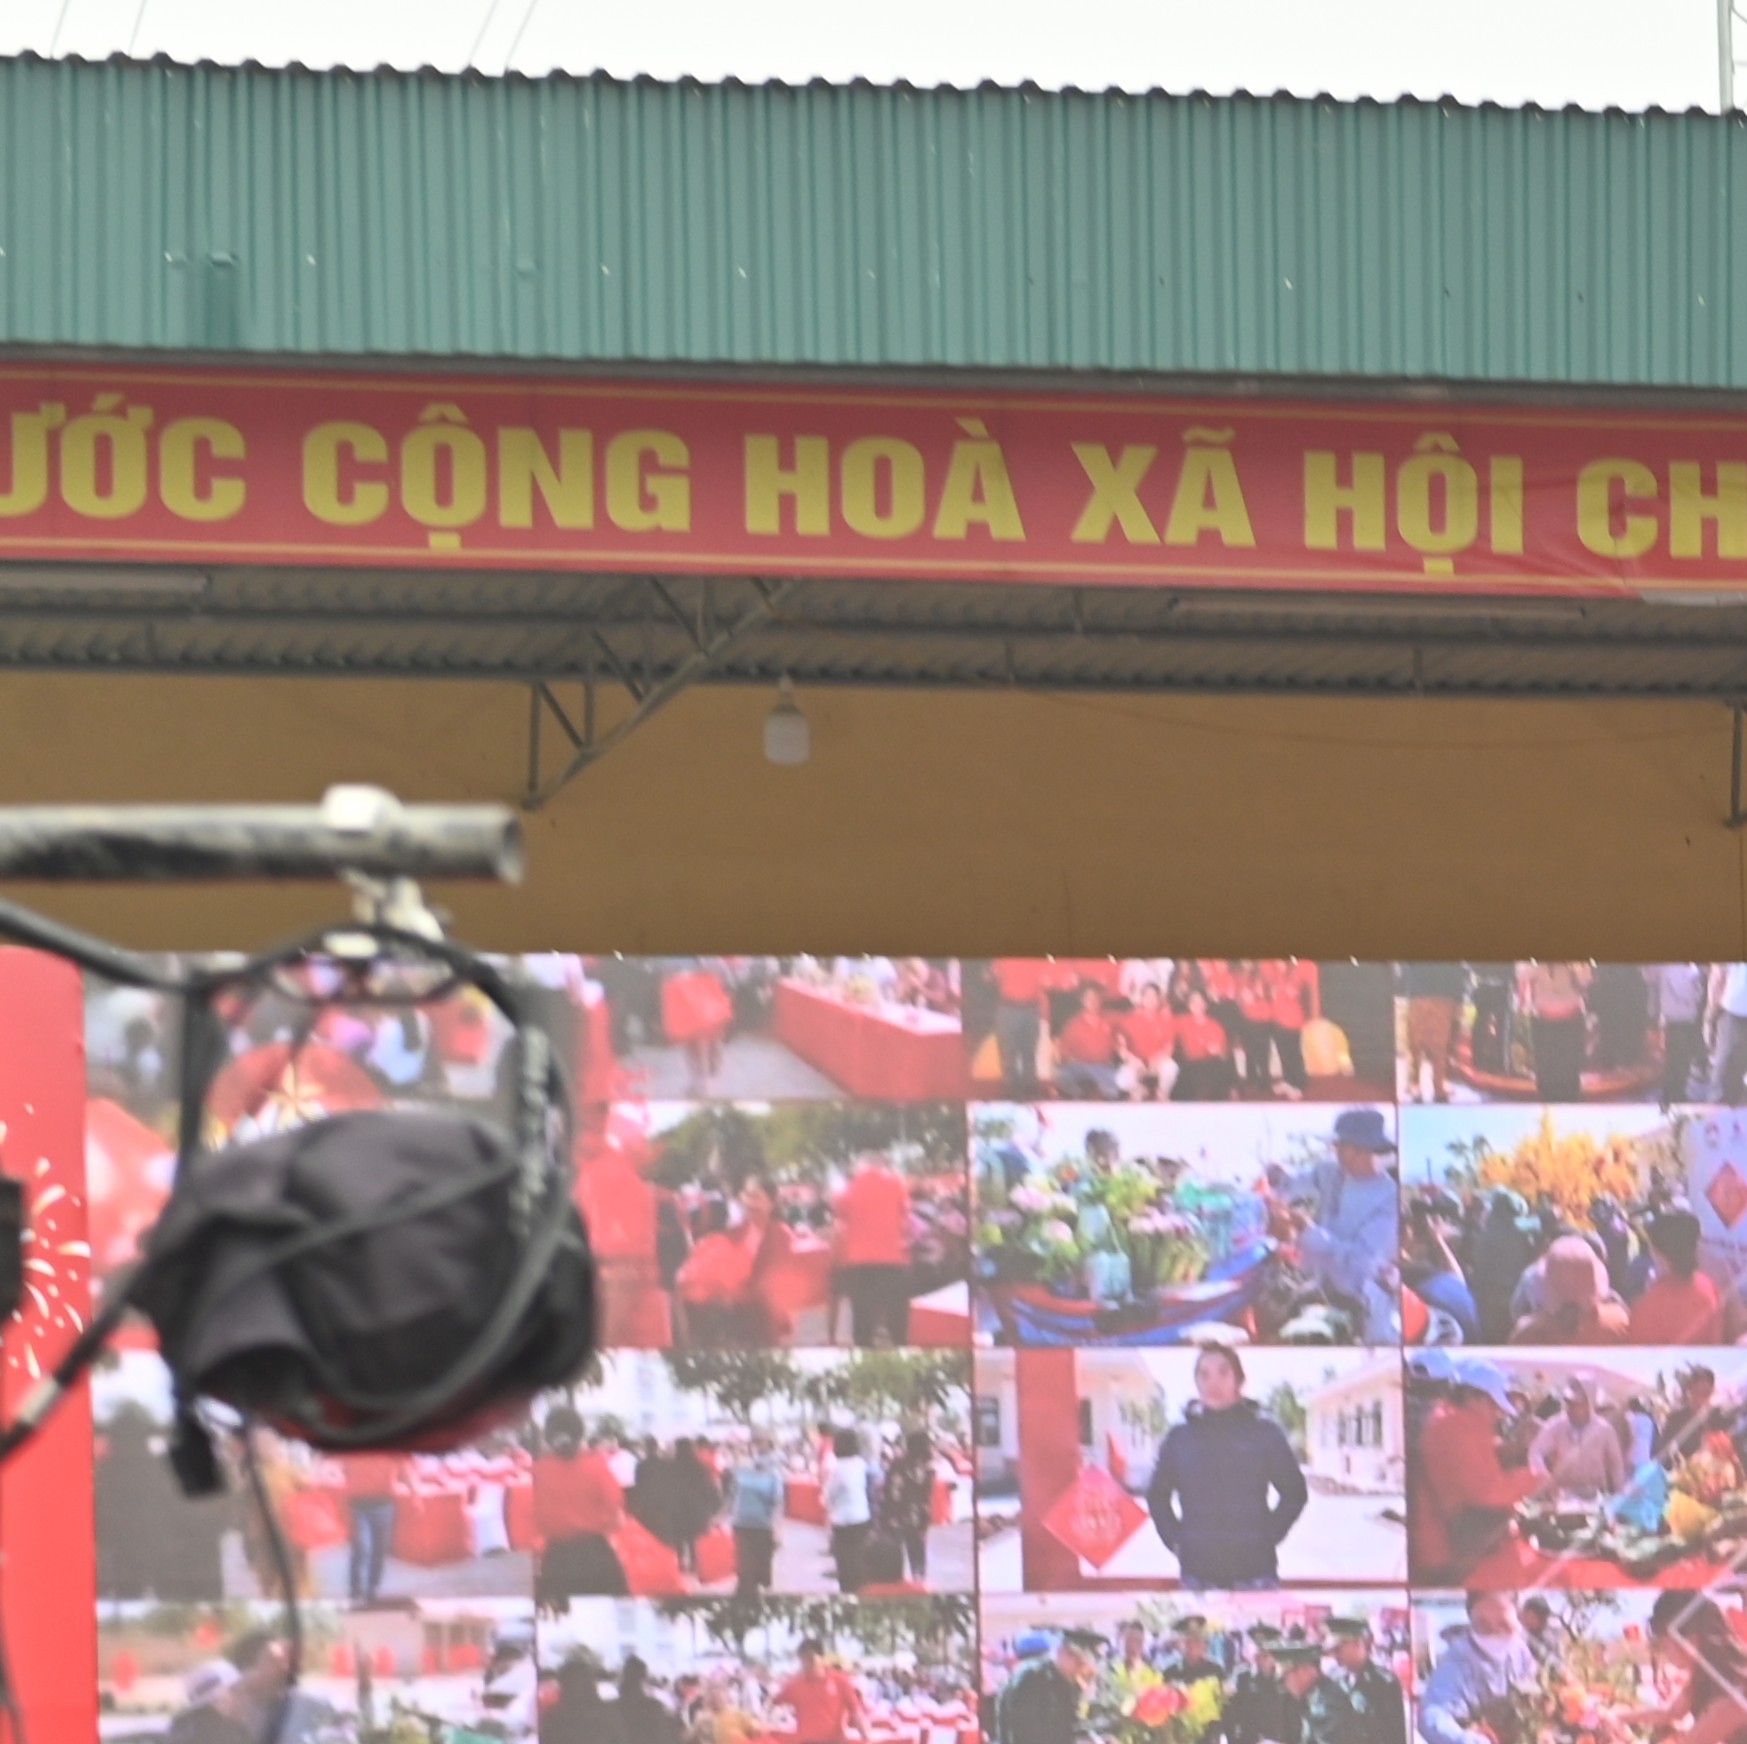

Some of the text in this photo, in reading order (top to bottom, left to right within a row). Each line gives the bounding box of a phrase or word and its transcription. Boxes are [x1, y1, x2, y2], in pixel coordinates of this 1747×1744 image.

[302, 402, 692, 551] CỘNG
[743, 415, 1026, 542] HOÀ
[1070, 425, 1257, 549] XÃ
[1302, 430, 1524, 576] HỘI
